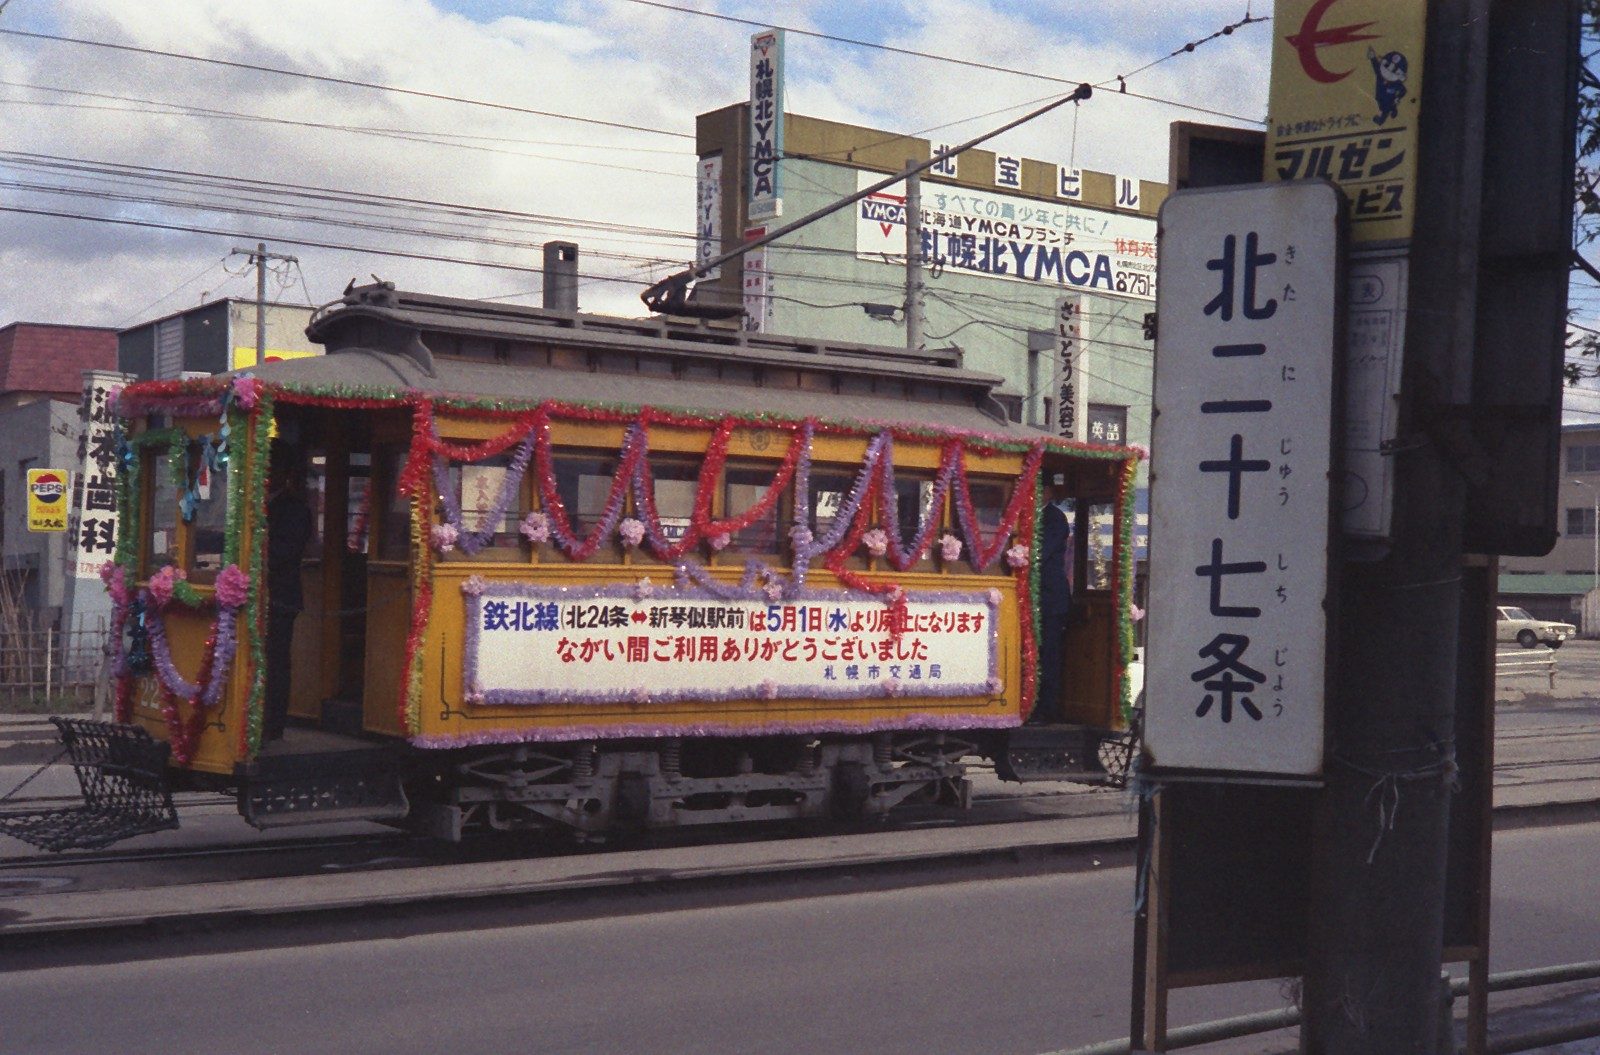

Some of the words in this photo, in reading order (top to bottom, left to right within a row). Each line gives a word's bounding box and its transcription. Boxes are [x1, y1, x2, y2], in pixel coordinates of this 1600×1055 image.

[754, 57, 774, 197] 札幌北YMCA
[933, 144, 1138, 206] 北宝ビル
[1275, 138, 1405, 181] マルゼン
[863, 202, 907, 223] YMCA
[919, 227, 1115, 292] 札幌北YMCA
[31, 484, 67, 494] PEPSI
[1191, 231, 1278, 724] 北二十七条
[824, 664, 942, 681] 札幌市交通局
